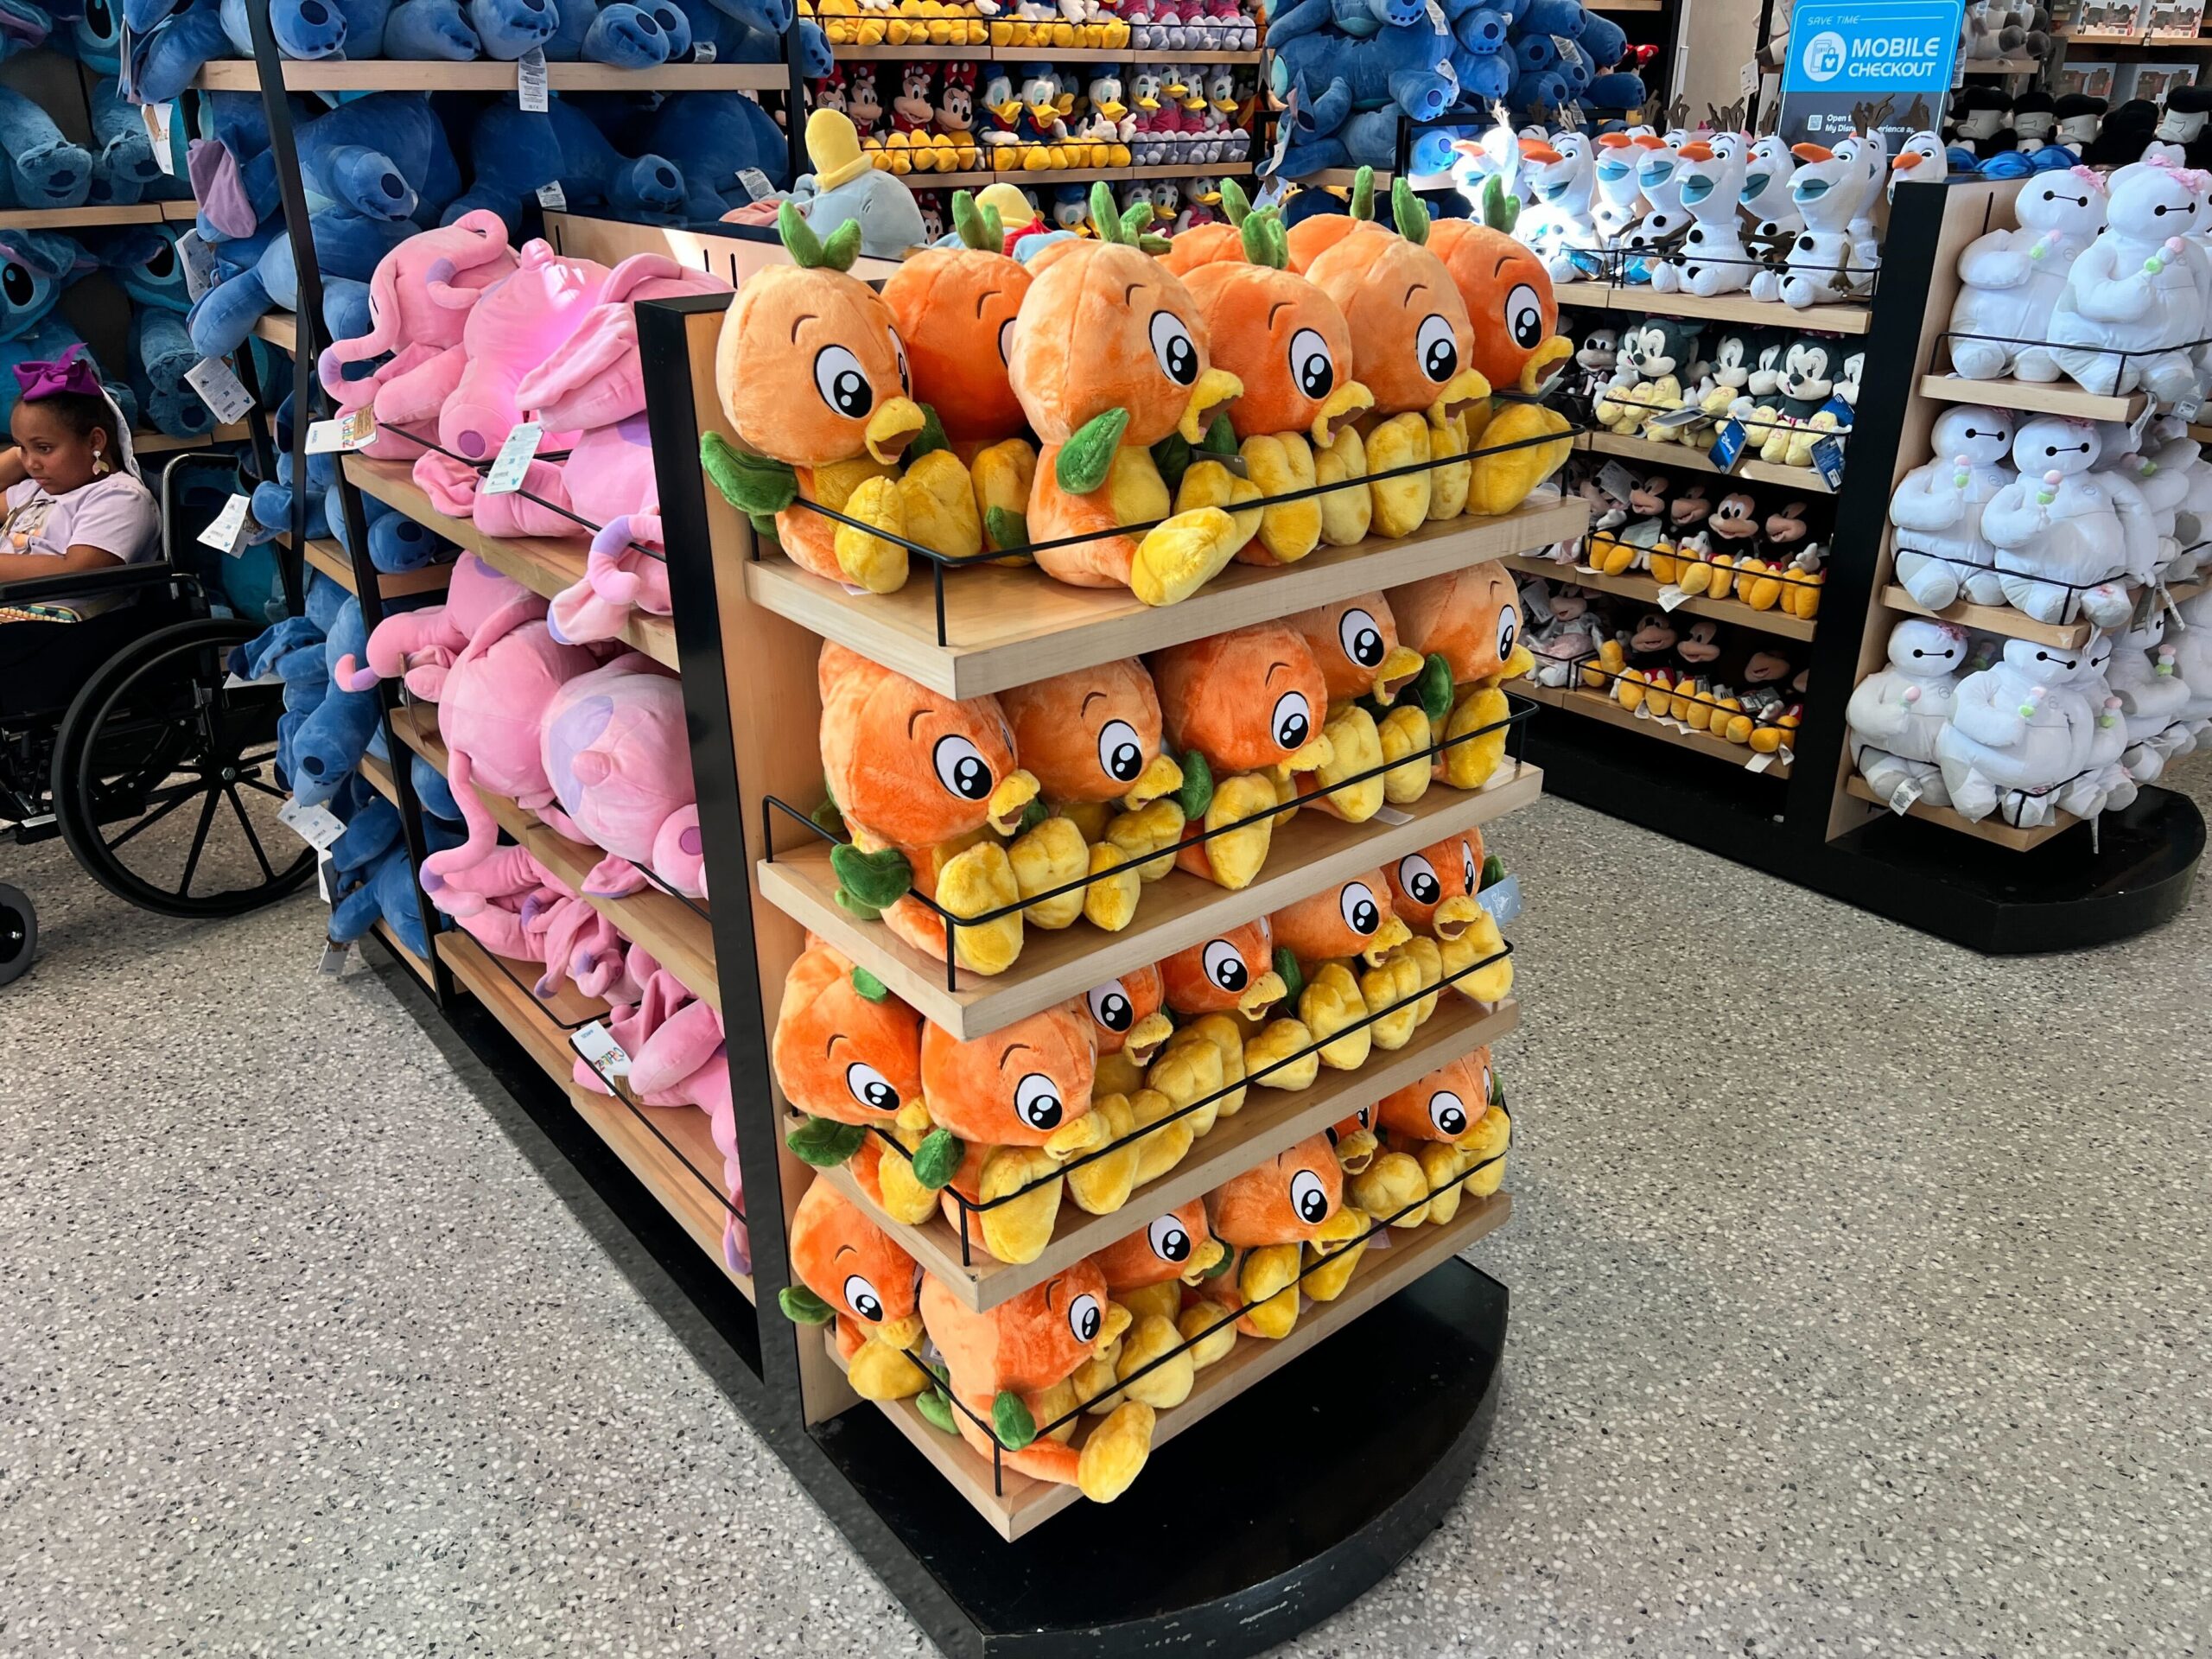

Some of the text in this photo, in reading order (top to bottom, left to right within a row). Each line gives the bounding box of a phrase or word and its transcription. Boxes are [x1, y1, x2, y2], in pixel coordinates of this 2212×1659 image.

[1807, 15, 1860, 26] SAVE TIME
[1851, 37, 1941, 58] MOBILE
[1848, 61, 1936, 77] CHECKOUT
[1827, 114, 1847, 123] Open
[1825, 124, 1837, 133] My
[1877, 124, 1904, 133] erience
[1721, 431, 1735, 454] Disney
